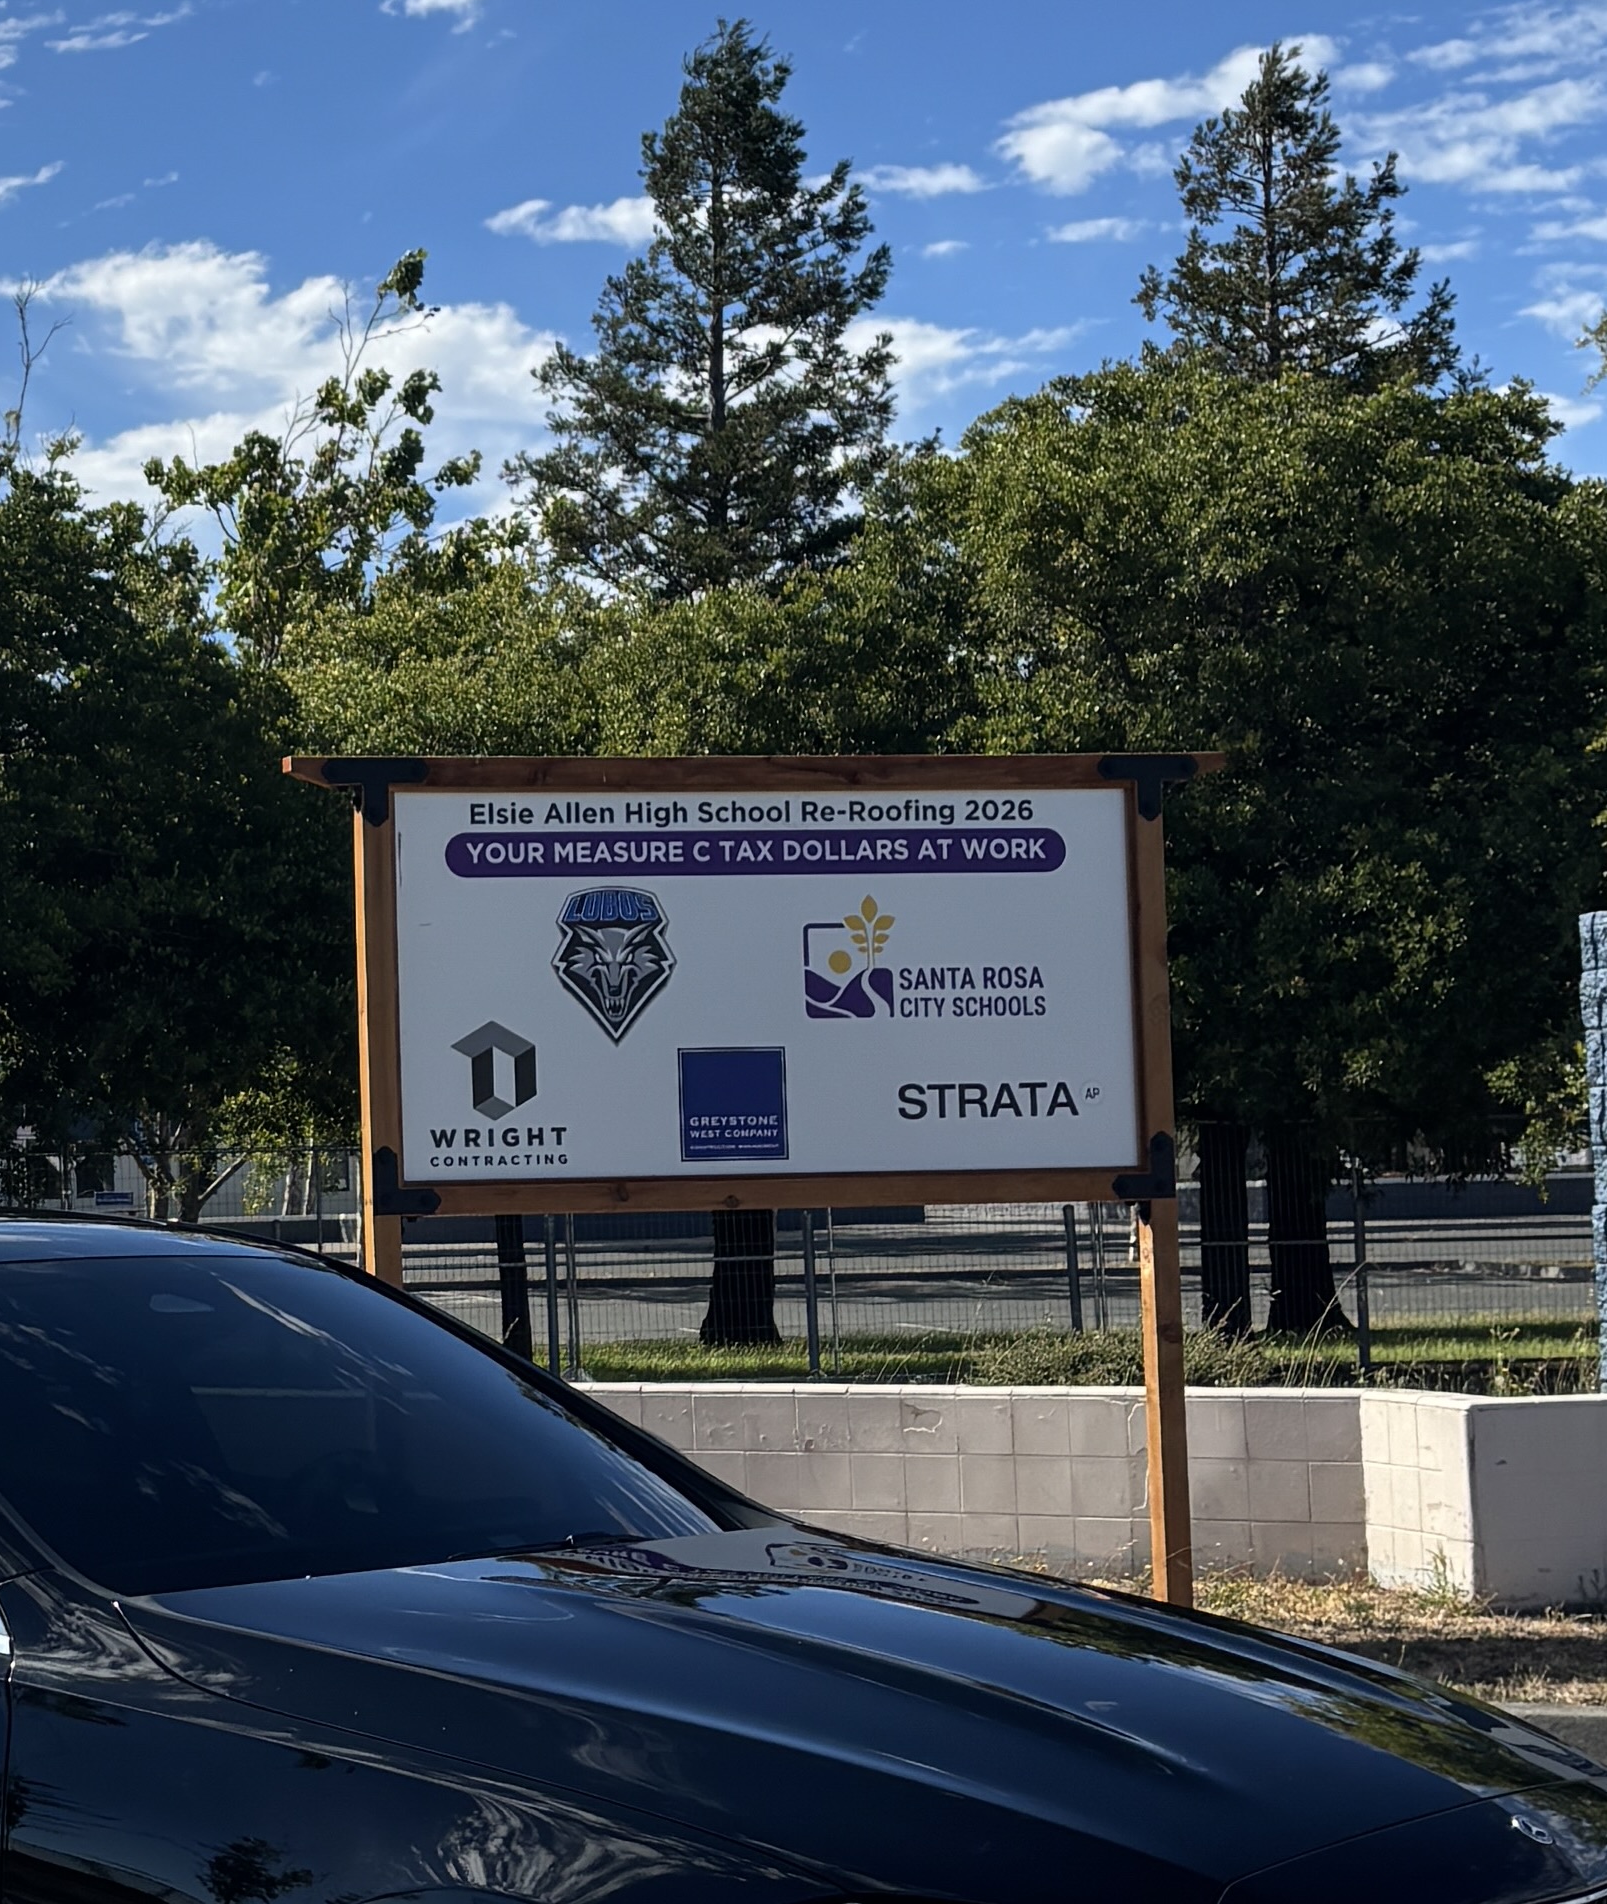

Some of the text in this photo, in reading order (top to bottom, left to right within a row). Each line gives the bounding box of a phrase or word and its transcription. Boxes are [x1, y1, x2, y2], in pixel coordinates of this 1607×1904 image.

[468, 799, 1034, 828] Elsie Allen High School Re-Roofing 2026
[465, 837, 1047, 864] YOUR MEASURE C TAX DOLLARS AT WORK
[563, 890, 659, 921] LOBOS
[899, 966, 1045, 990] SANTA ROSA
[899, 995, 1047, 1018] CITY SCHOOLS
[898, 1081, 1101, 1120] STRATA AP
[689, 1115, 778, 1127] GREYSTONE
[430, 1127, 567, 1149] WRIGHT
[689, 1128, 778, 1139] WEST COMPANY
[430, 1154, 568, 1167] CONTRACTING
